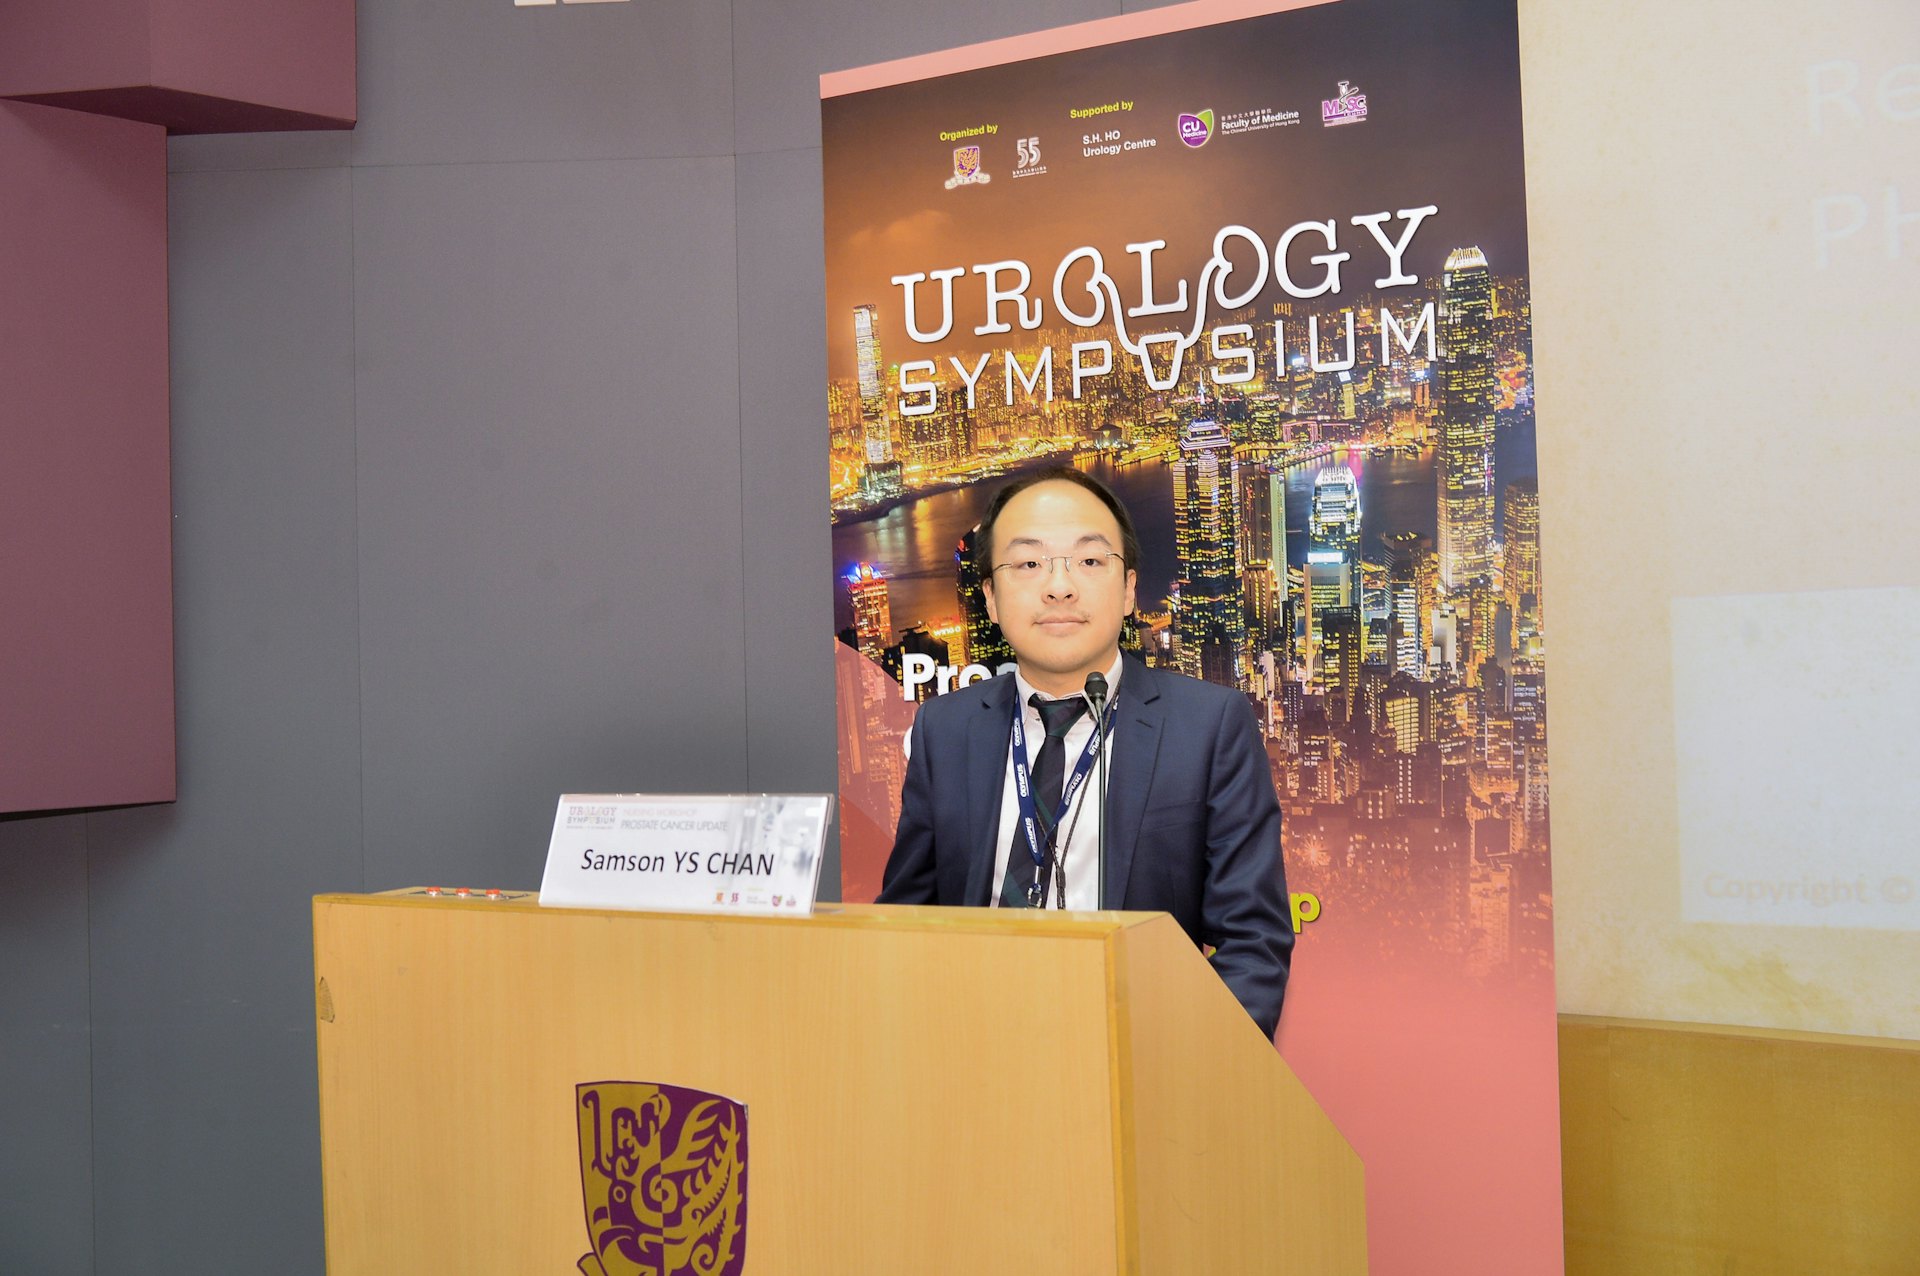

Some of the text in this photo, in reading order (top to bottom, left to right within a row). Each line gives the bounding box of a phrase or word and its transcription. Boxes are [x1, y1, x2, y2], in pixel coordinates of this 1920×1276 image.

[1070, 100, 1133, 118] Supported by
[1221, 110, 1299, 130] Faculty of Medicine
[940, 124, 998, 141] Organized by
[1082, 130, 1120, 145] S.H. HO
[1182, 120, 1200, 133] CU
[1016, 137, 1041, 169] 55
[1083, 138, 1157, 157] Urology Centre
[891, 205, 1440, 344] UROLOGY
[898, 302, 1439, 417] SYMPOSIUM
[902, 653, 1018, 702] Pro
[1016, 763, 1028, 798] OLYMPUS
[620, 820, 728, 832] PROSTATE CANCER UPDATE
[1025, 817, 1037, 853] OLYMPUS
[581, 849, 775, 876] Samson YS CHAN
[1703, 871, 1868, 908] Copyright
